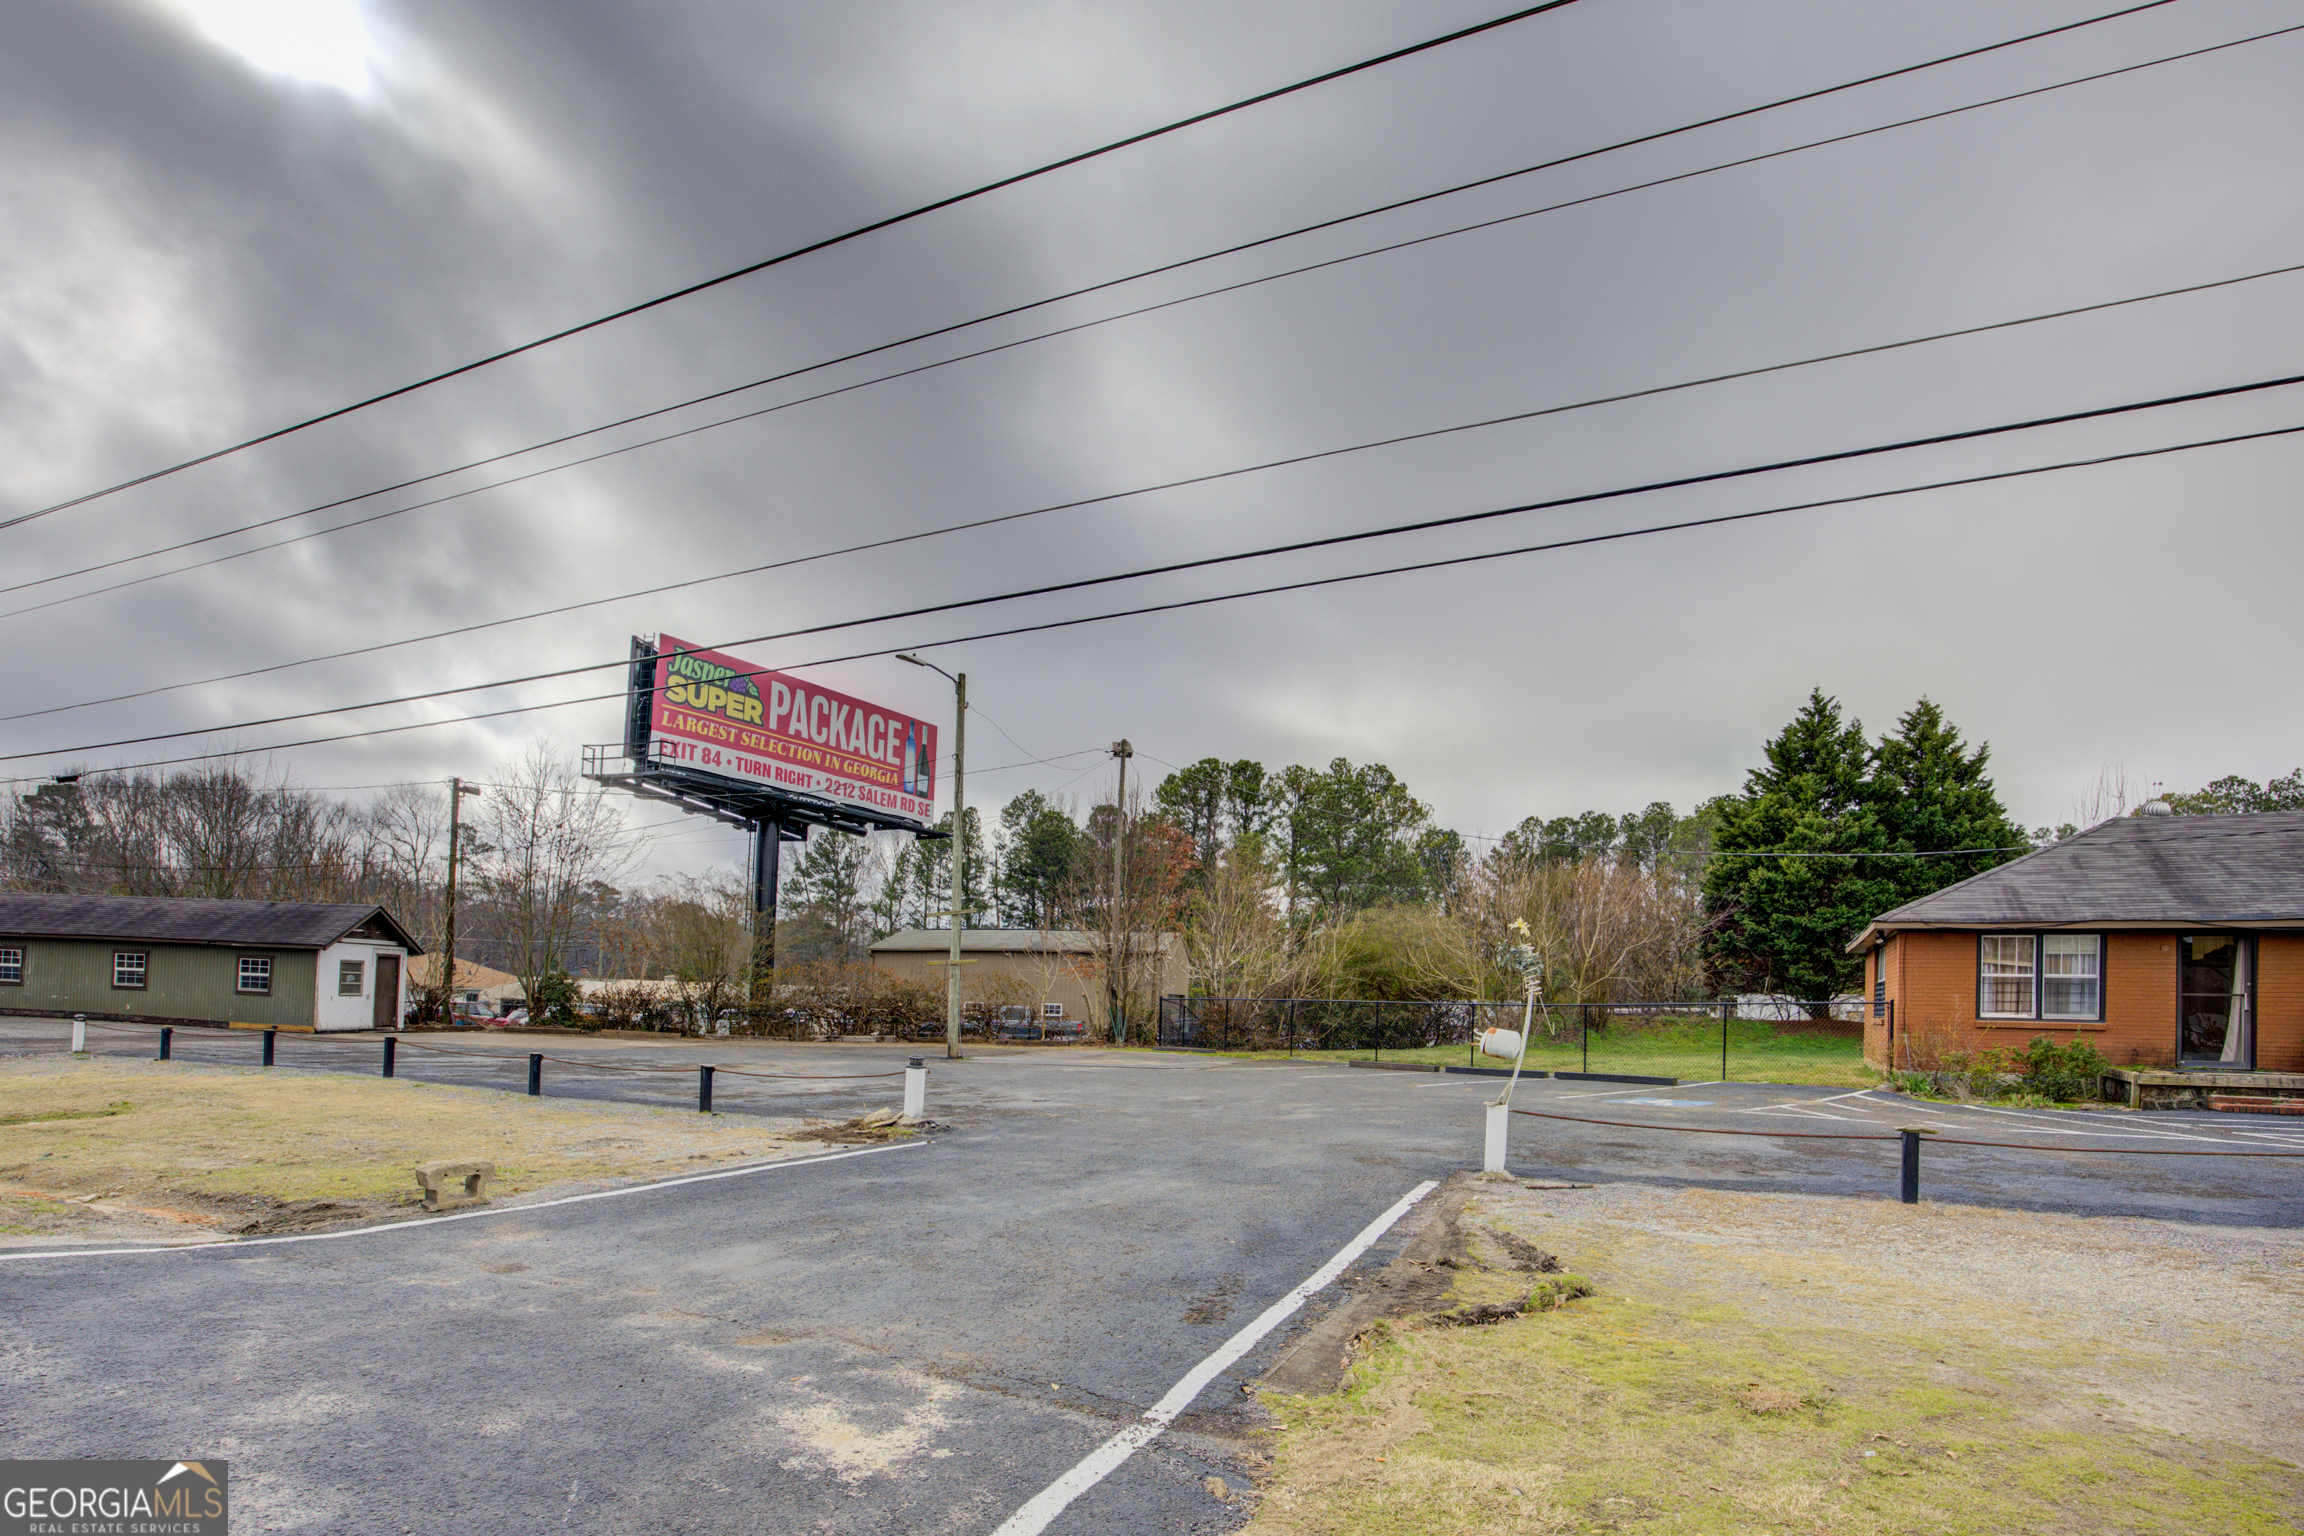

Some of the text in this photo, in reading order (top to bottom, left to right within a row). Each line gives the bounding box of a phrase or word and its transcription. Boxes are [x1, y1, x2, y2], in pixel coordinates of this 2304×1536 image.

[665, 675, 763, 725] SUPER
[668, 647, 735, 687] Jasper
[661, 710, 898, 786] LARGEST SELECTION IN GEORGIA
[769, 680, 902, 765] PACKAGE
[660, 737, 698, 762] EXIT
[701, 747, 722, 767] 84
[735, 756, 771, 779] TURN
[775, 766, 813, 789] RIGHT
[825, 777, 855, 799] 2212
[858, 786, 897, 809] SALEM
[900, 796, 915, 813] RD
[918, 801, 931, 817] SE
